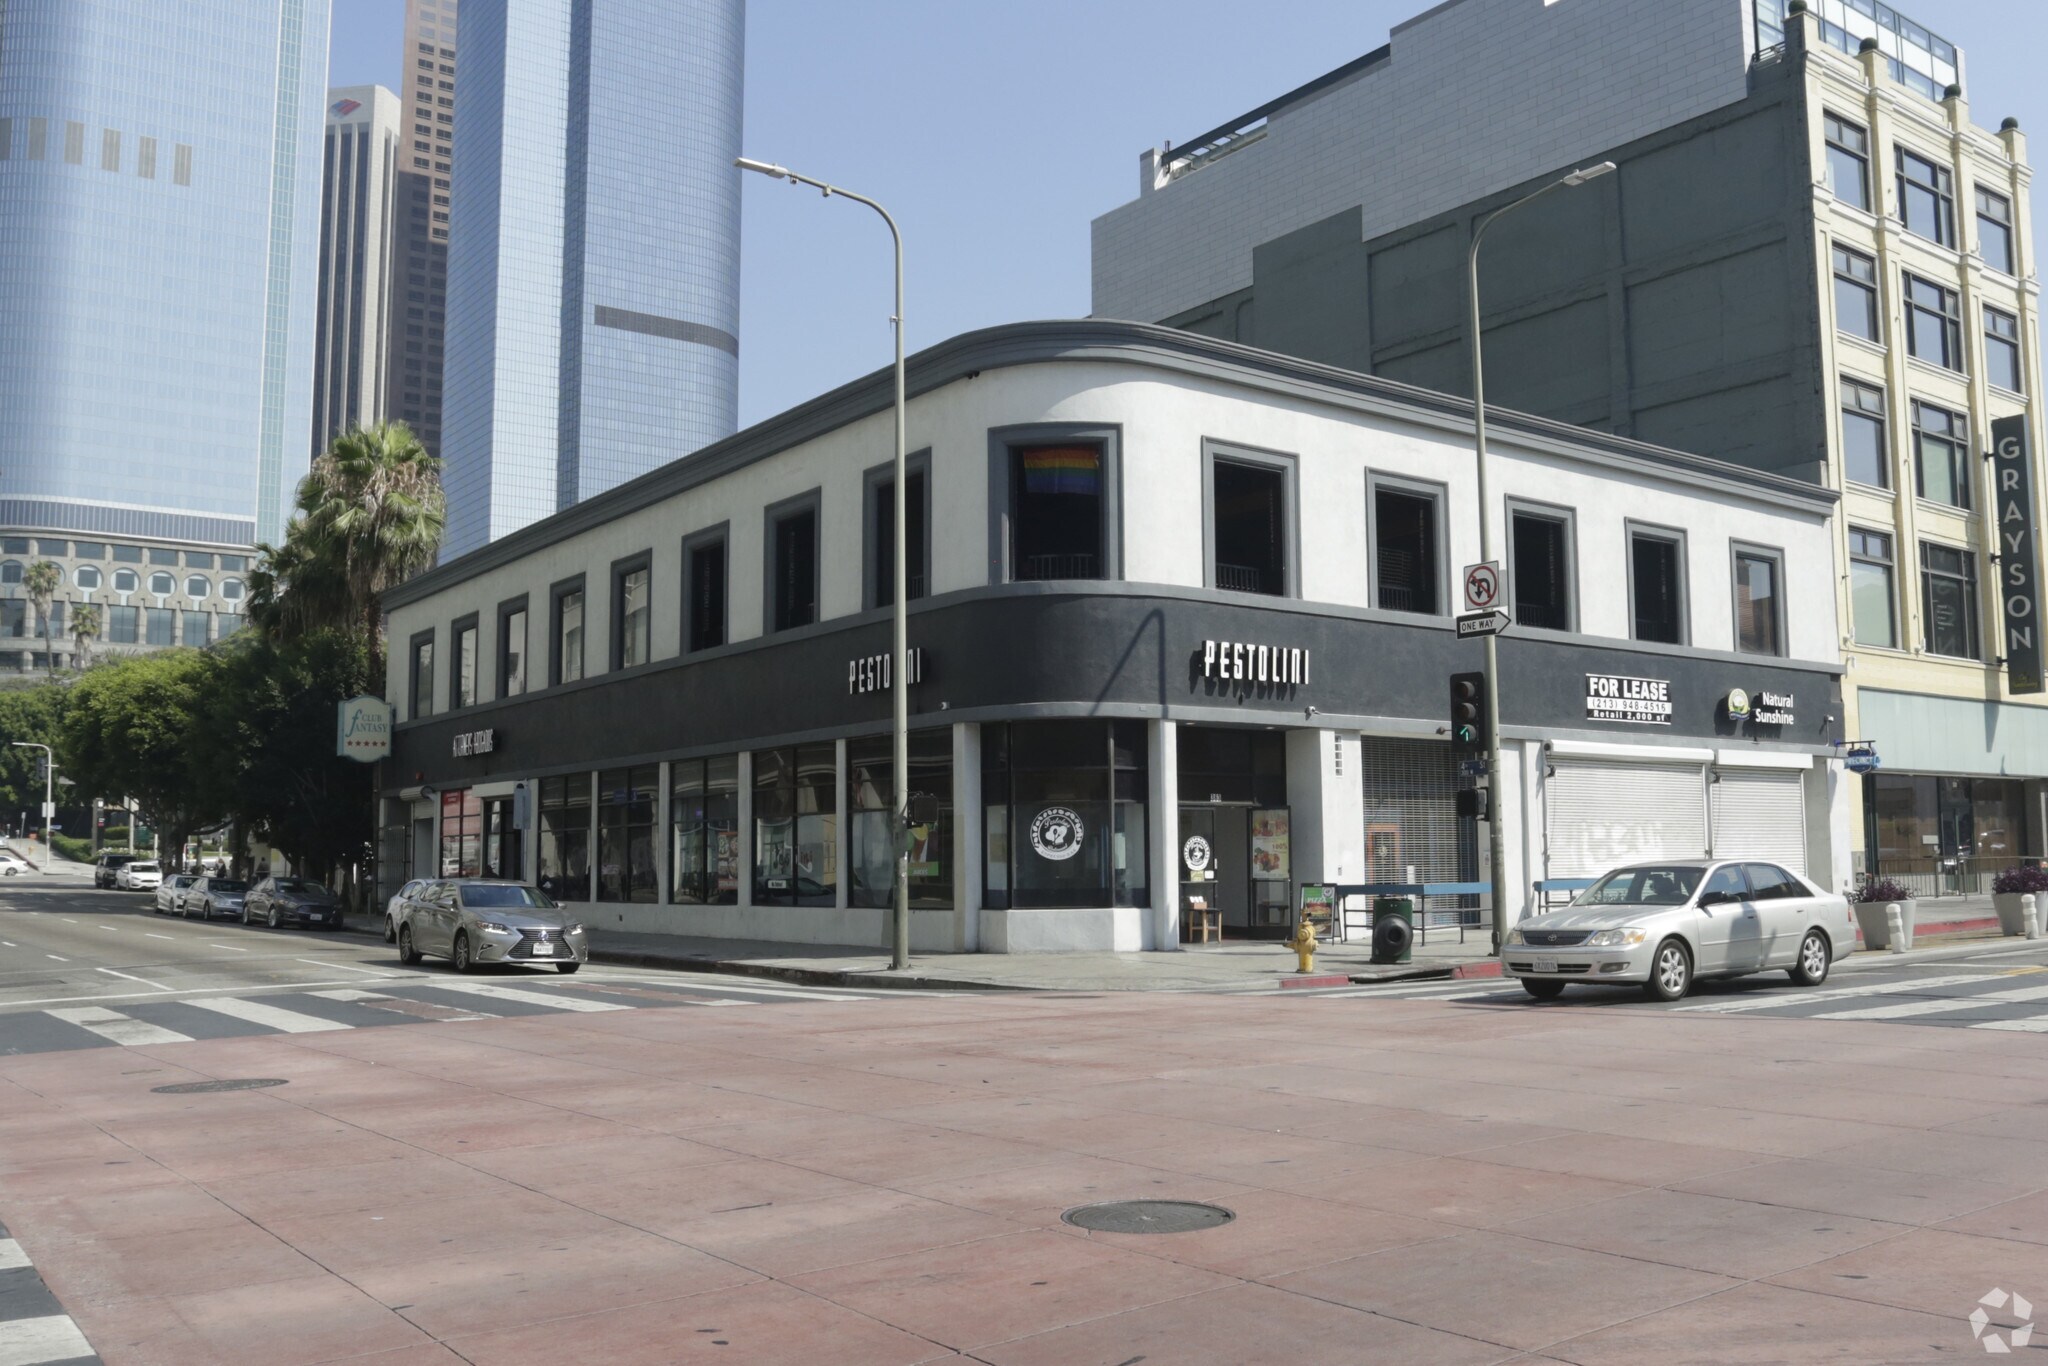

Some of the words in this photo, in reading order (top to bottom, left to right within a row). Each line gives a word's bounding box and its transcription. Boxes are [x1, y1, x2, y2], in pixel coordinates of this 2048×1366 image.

[1998, 436, 2031, 650] GRAYSON
[1461, 621, 1477, 632] ONE
[1479, 619, 1495, 630] WAY
[849, 647, 921, 695] PESTONI
[1204, 640, 1309, 685] PESTOLINI
[1589, 677, 1620, 698] FOR
[1623, 680, 1668, 701] LEASE
[1592, 698, 1618, 709] (213)
[1762, 691, 1794, 708] Natural
[361, 714, 382, 722] CLUB
[1593, 709, 1623, 719] Retail
[1755, 708, 1794, 725] Sunshine
